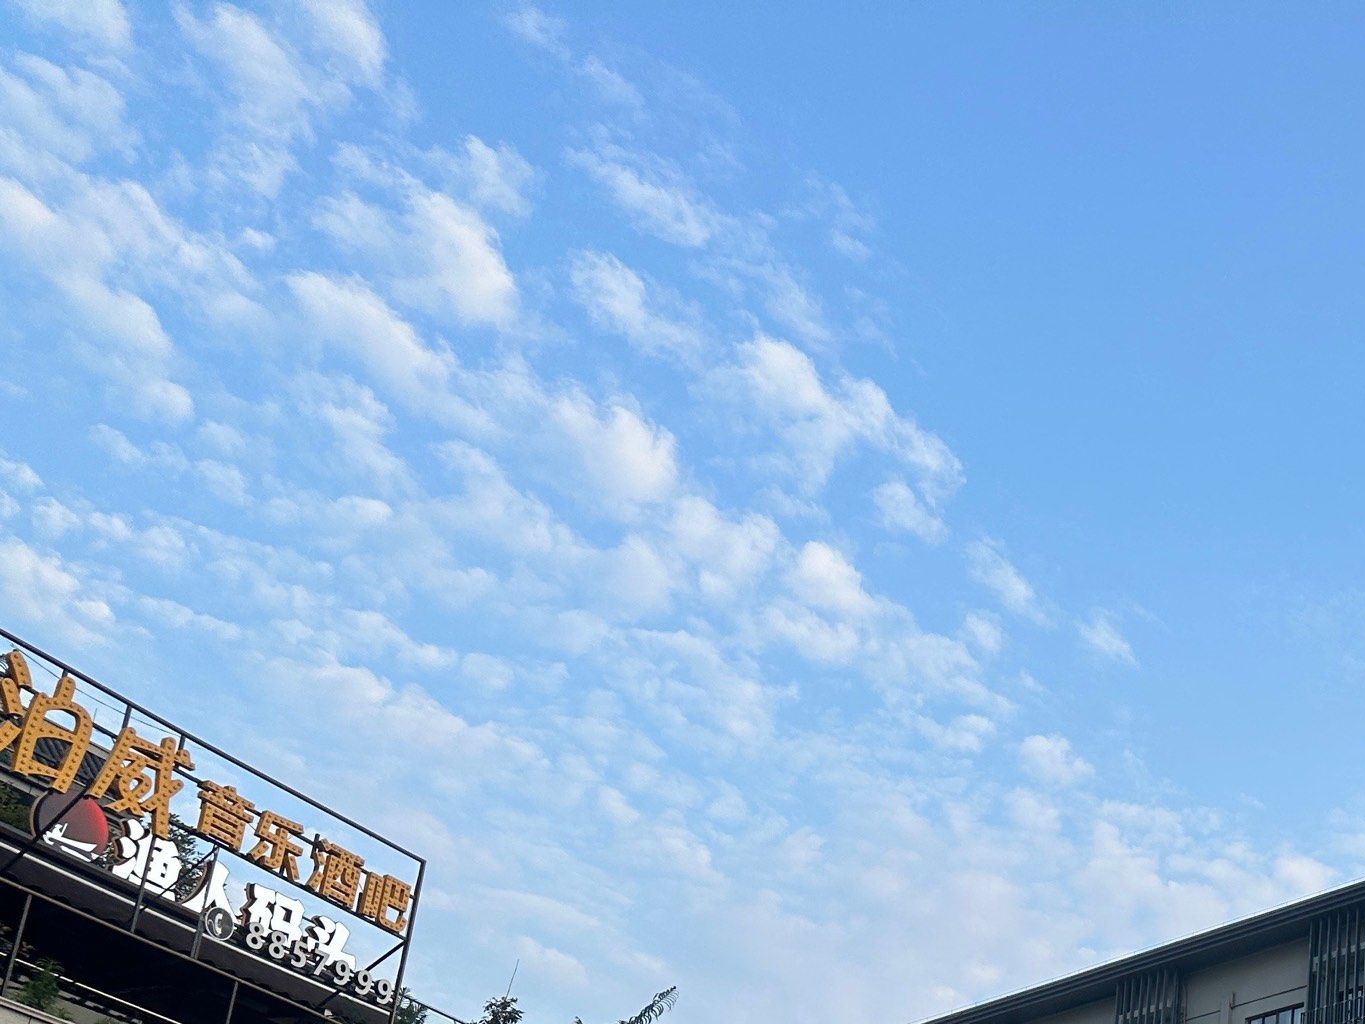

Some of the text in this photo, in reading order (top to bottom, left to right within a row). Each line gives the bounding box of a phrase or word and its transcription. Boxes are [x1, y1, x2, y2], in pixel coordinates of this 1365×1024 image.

[112, 818, 356, 968] 渔人码头
[245, 921, 394, 1005] 8857999
